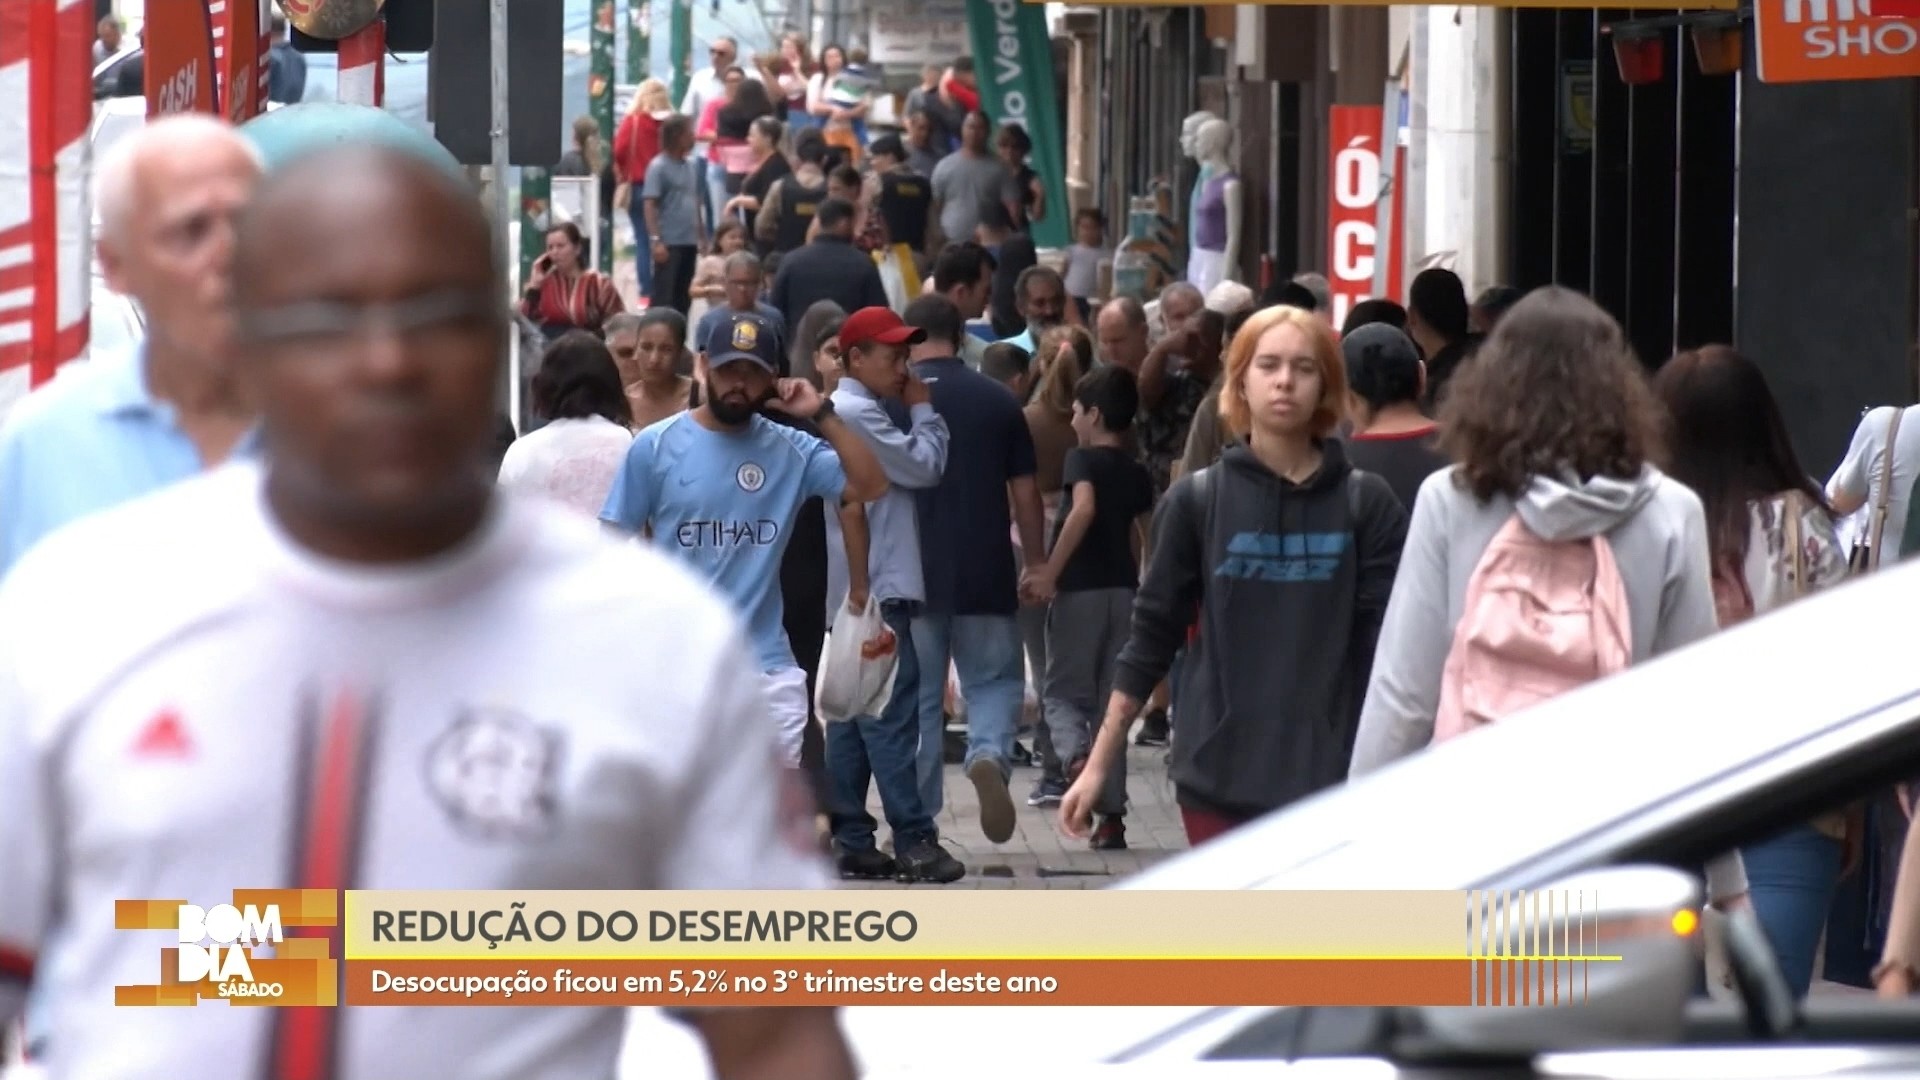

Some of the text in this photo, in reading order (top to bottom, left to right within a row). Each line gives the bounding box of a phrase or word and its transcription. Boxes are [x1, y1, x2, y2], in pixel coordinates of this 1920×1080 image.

[1804, 23, 1917, 58] SHO
[159, 58, 198, 115] CASH
[677, 519, 778, 548] ETIHAD
